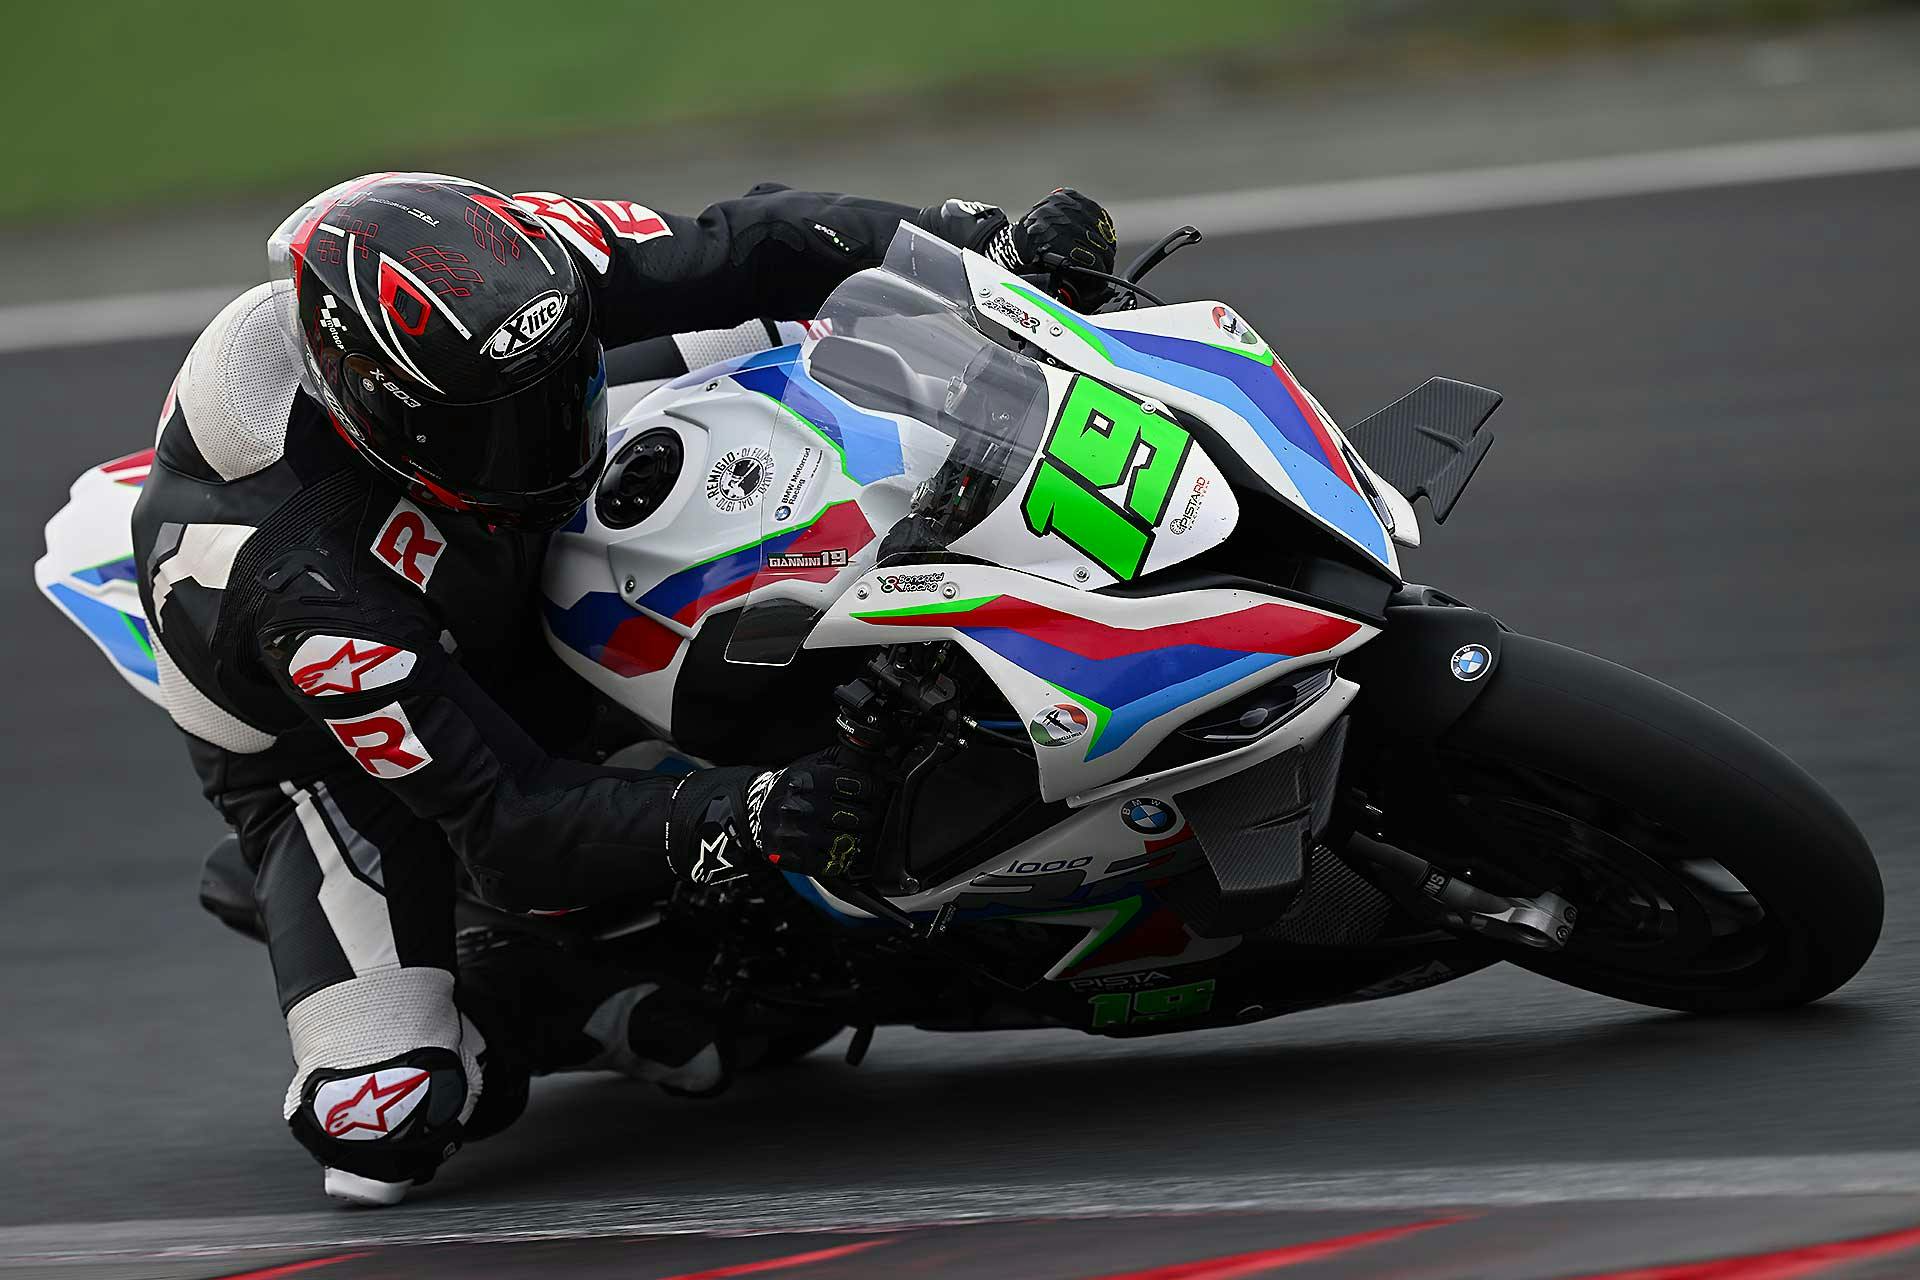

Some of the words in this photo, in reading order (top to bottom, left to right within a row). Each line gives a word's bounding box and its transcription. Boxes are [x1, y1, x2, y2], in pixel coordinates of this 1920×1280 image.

[500, 301, 559, 357] X-lite
[369, 368, 421, 408] X-803
[706, 451, 736, 499] REMIGIO
[781, 483, 796, 504] BMW
[791, 447, 811, 482] Motorrad
[788, 479, 806, 505] Racing
[1020, 372, 1196, 584] 19
[715, 497, 736, 513] 1970
[739, 496, 754, 511] DAL
[1179, 476, 1206, 529] PISTARD
[769, 557, 821, 567] GIANNINI
[820, 549, 848, 567] 19
[1121, 799, 1162, 816] BMW
[1007, 856, 1093, 874] 1000
[1087, 978, 1217, 1034] 19
